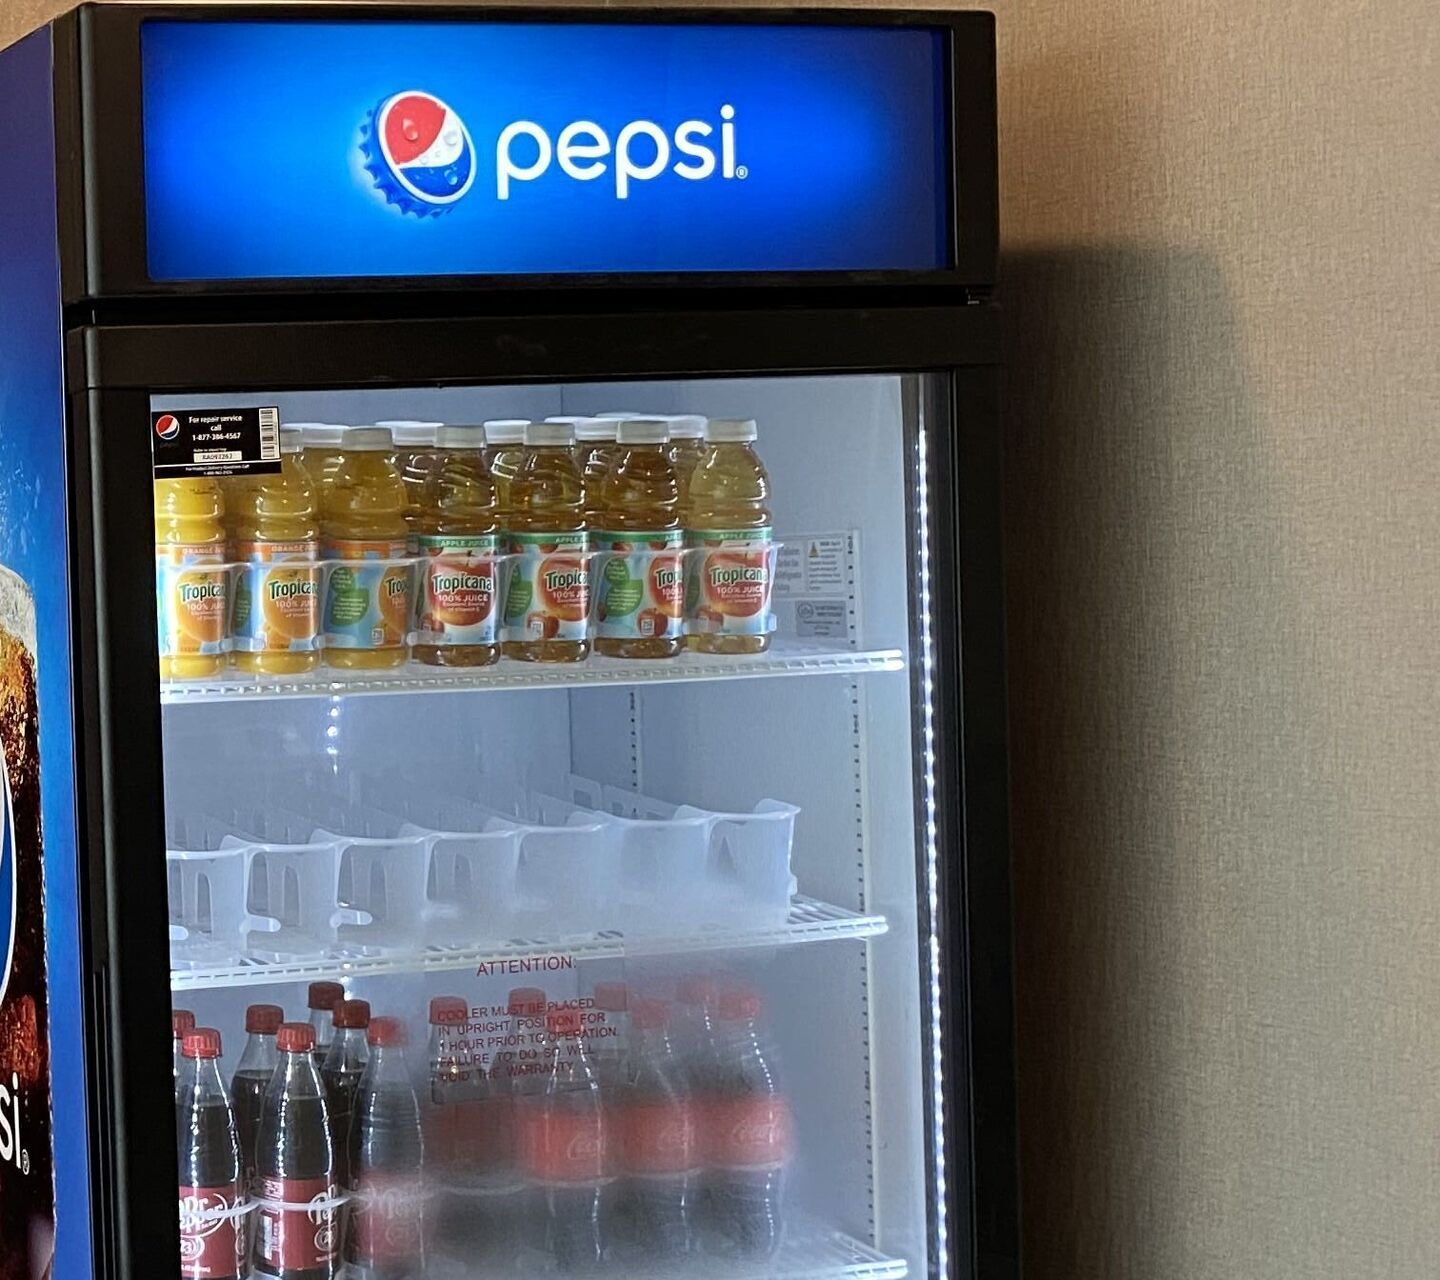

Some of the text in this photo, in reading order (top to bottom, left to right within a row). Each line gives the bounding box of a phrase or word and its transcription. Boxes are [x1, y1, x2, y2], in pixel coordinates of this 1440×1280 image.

[496, 104, 738, 201] pepsi
[201, 416, 220, 424] repair
[210, 424, 222, 432] call
[272, 544, 303, 552] ORANGE
[440, 539, 489, 547] APPLE JUICE
[433, 572, 494, 594] Tropicana
[439, 593, 488, 603] 100% JUICE
[438, 997, 595, 1021] COOLER MUST BE PLACED
[438, 1011, 606, 1037] IN UPRIGHT POSITION FOR
[449, 1038, 484, 1052] HOUR
[487, 1034, 524, 1047] PRIOR
[529, 1032, 545, 1045] TO
[440, 1042, 595, 1067] FAILURE TO DO SO WILL
[478, 1067, 498, 1080] THE
[507, 1060, 574, 1076] WARRANTY
